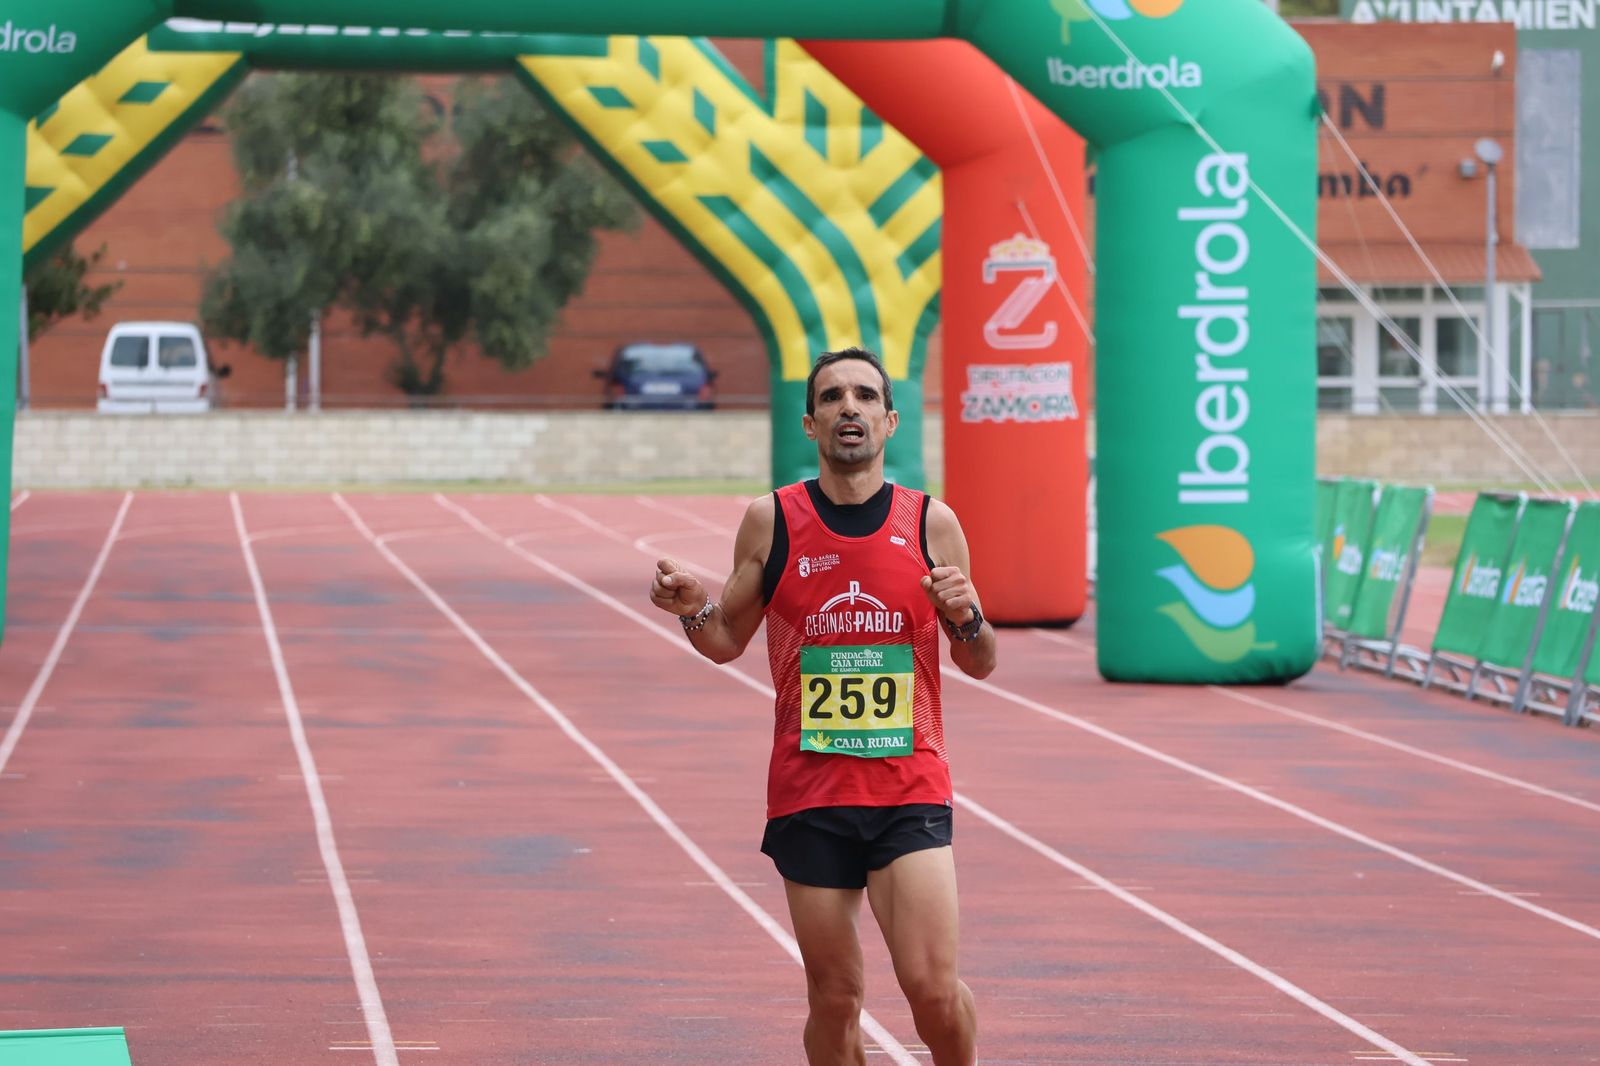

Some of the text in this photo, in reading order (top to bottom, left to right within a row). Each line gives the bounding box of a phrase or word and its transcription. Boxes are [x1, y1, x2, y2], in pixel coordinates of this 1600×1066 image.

[1352, 0, 1600, 29] AYUNTAMIEN
[1047, 55, 1202, 89] Iberdrola
[1178, 153, 1250, 503] Iberdrola
[961, 392, 1079, 422] ZAMORA
[805, 610, 904, 637] CECINAS PABLO
[831, 659, 884, 668] CAJA RURAL
[809, 676, 897, 720] 259
[834, 736, 908, 749] CAJA RURAL
